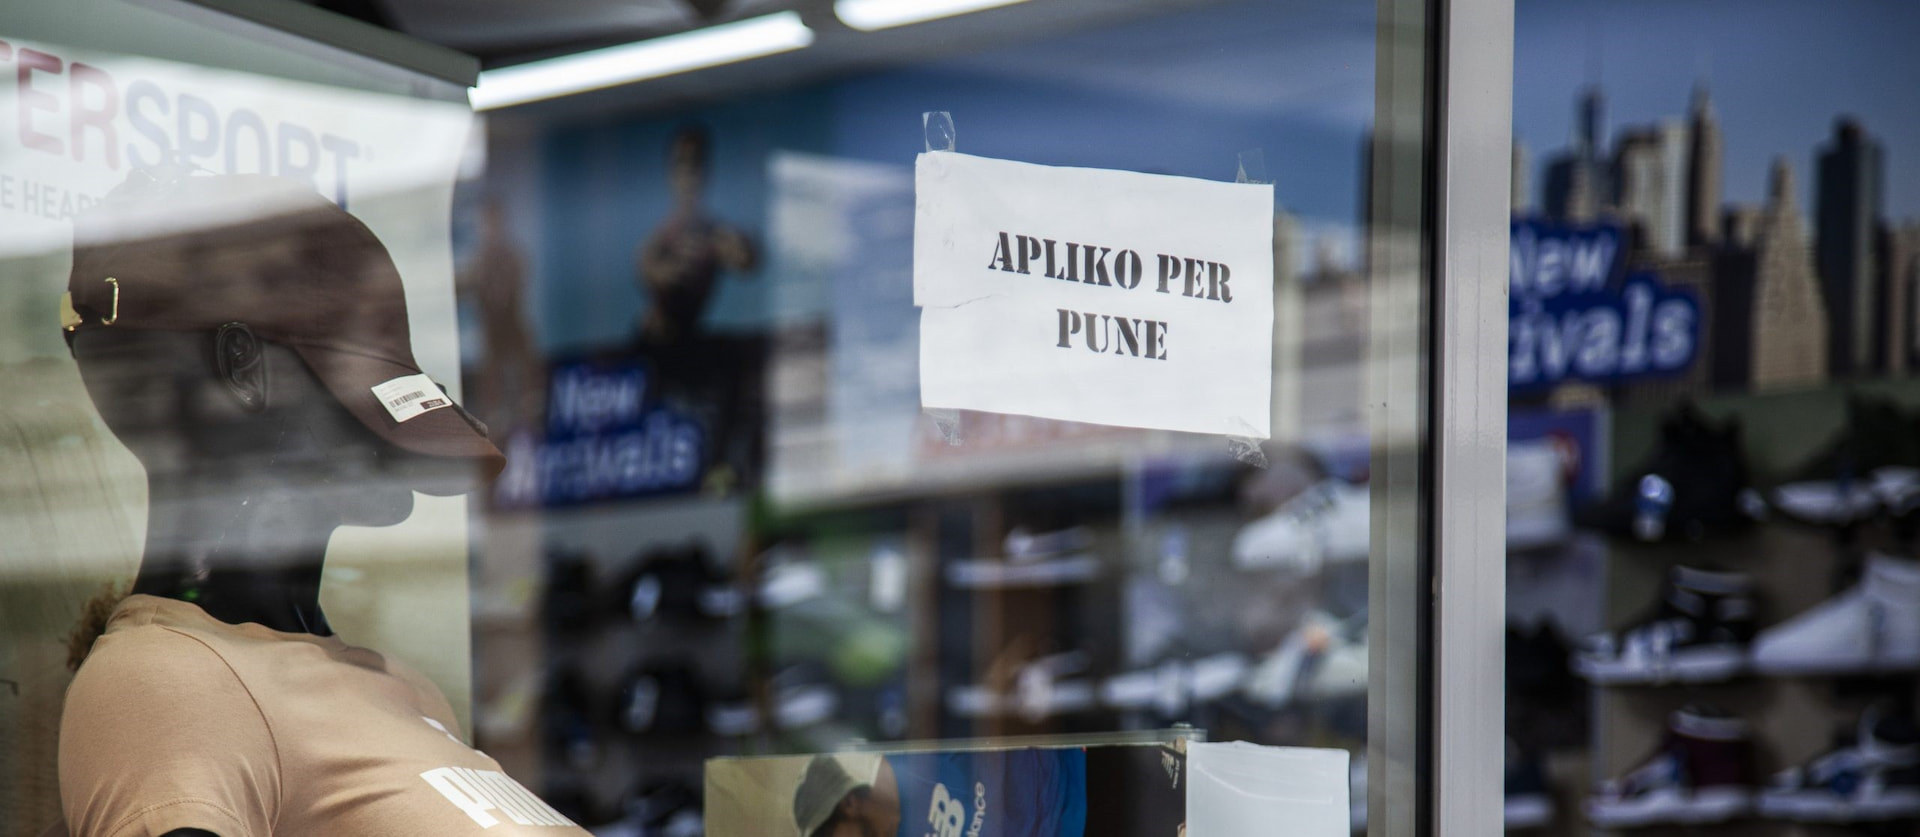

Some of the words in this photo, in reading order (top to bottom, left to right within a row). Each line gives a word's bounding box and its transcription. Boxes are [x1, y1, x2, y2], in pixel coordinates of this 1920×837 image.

[988, 231, 1143, 290] APLIKO
[1156, 253, 1233, 304] PER
[1056, 308, 1168, 361] PUNE
[1510, 281, 1695, 382] ivals
